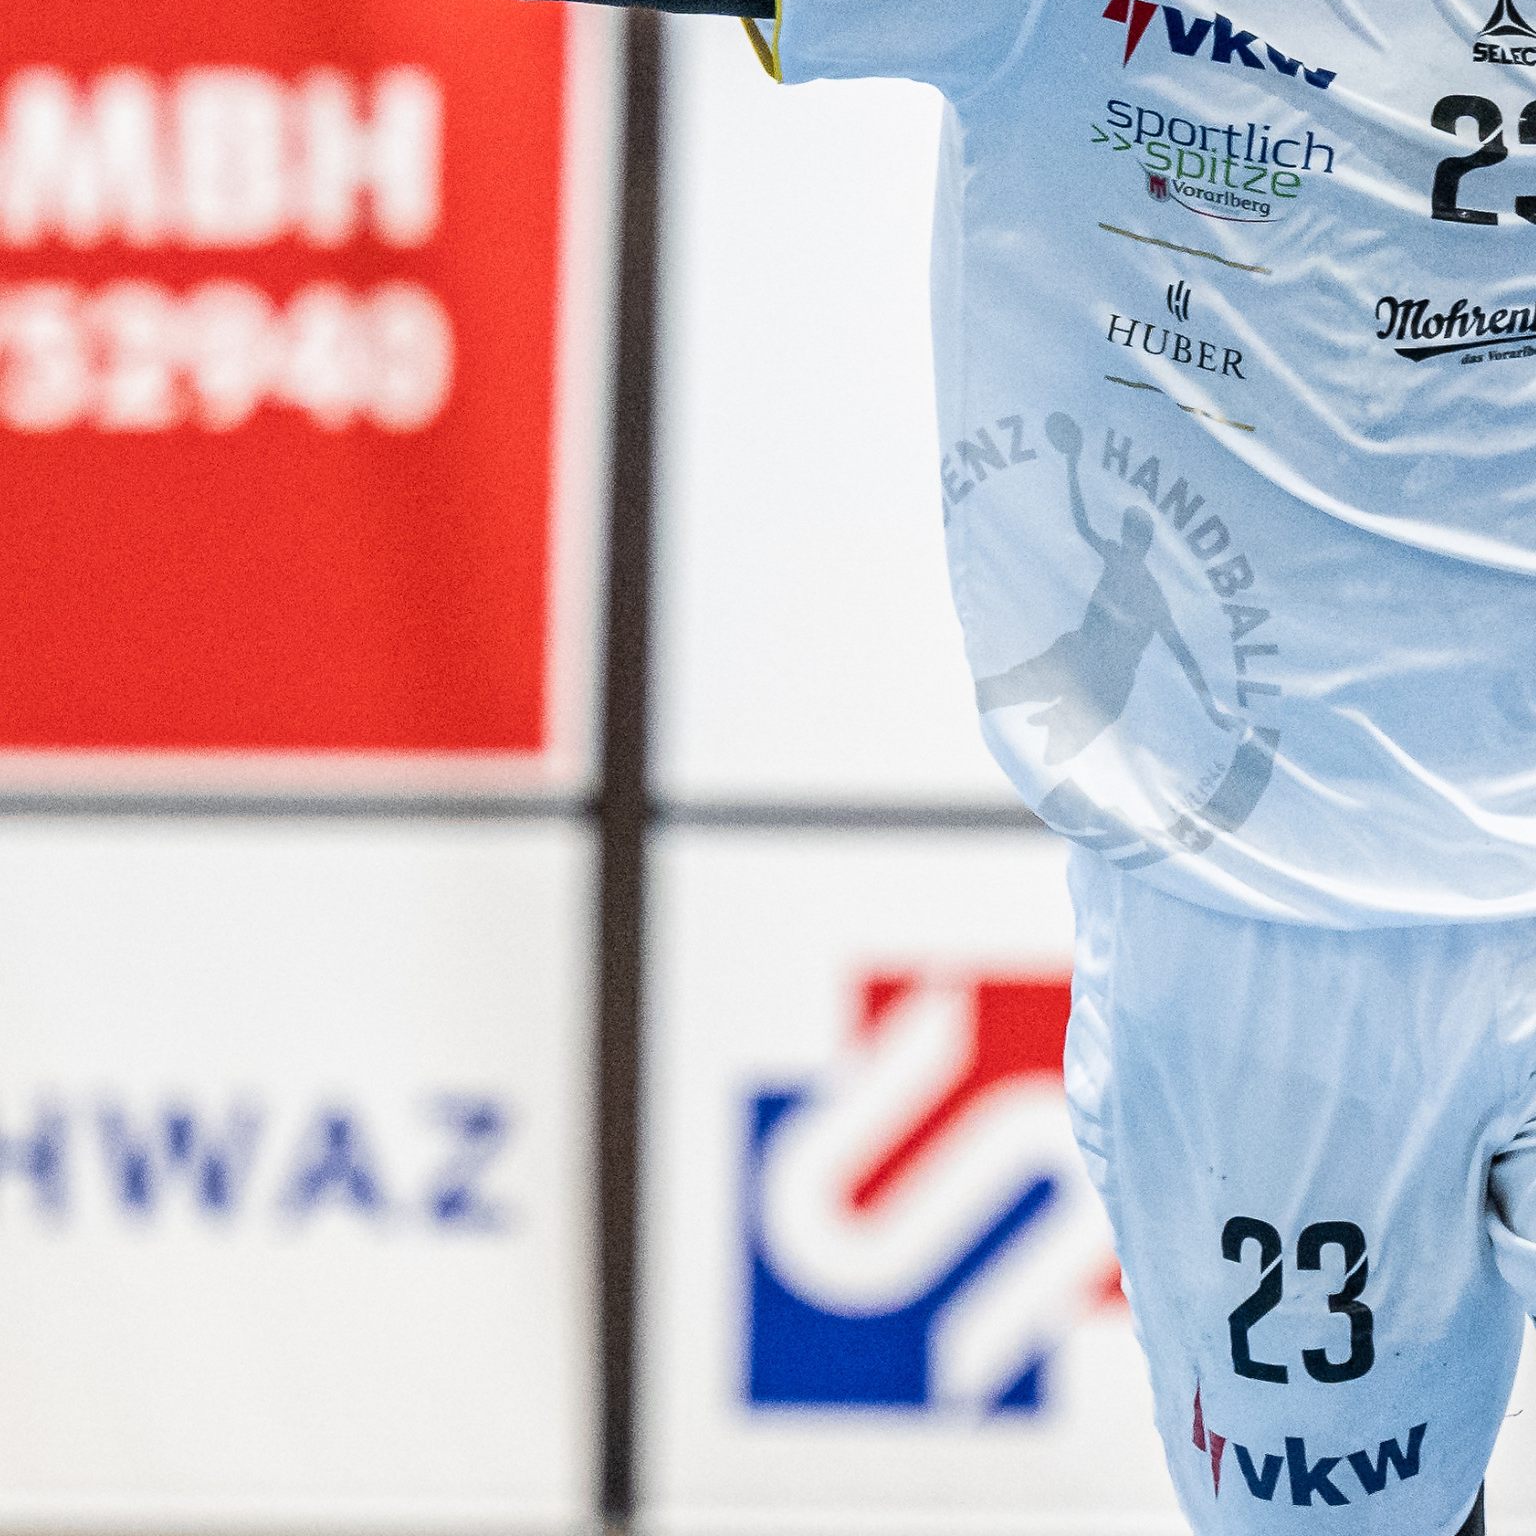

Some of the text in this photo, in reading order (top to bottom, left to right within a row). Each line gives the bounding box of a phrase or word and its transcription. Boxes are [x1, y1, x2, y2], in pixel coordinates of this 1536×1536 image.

[1106, 98, 1335, 174] sportlich
[1172, 178, 1271, 218] Vorarlberg
[1105, 313, 1247, 380] HUBER
[1461, 352, 1484, 365] das
[941, 413, 1283, 710] ENZ HANDBALL
[1220, 1214, 1376, 1385] 23
[1232, 1421, 1429, 1507] vkw
